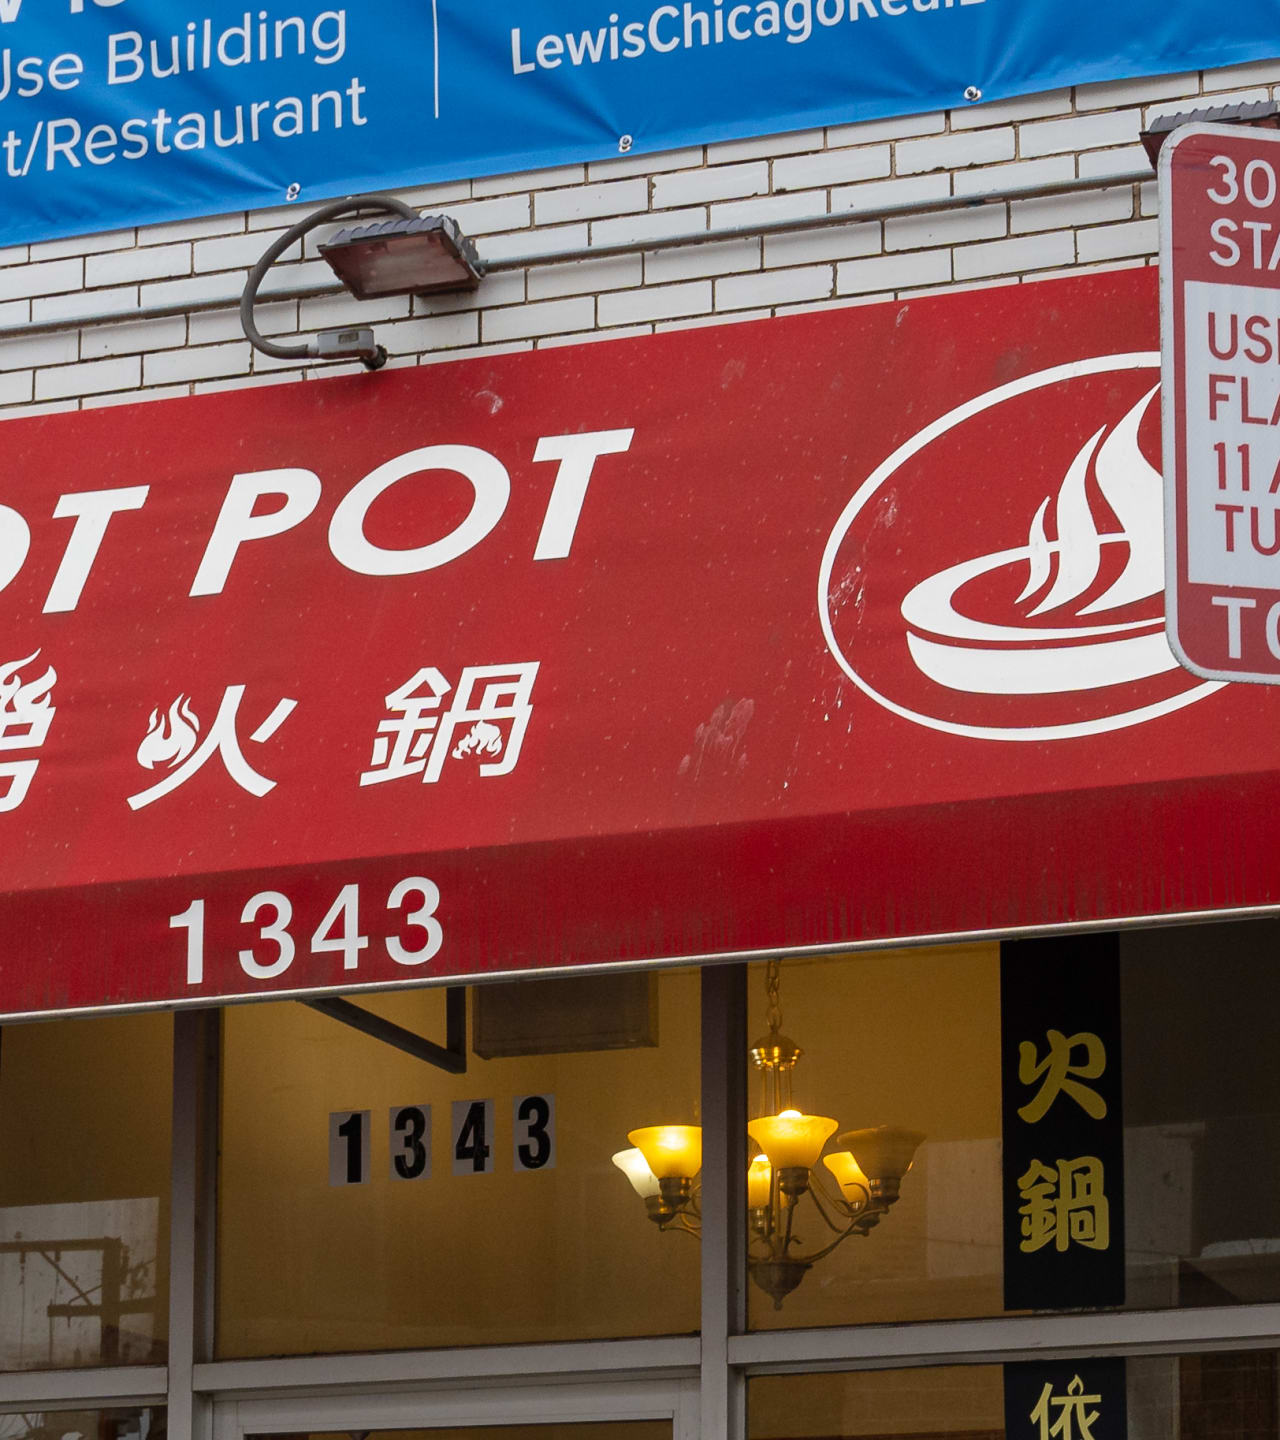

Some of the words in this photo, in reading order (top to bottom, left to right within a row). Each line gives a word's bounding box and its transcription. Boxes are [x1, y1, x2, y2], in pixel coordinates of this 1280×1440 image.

[107, 8, 347, 85] Building
[511, 0, 985, 75] LewisChicago
[1206, 155, 1277, 209] 30
[188, 428, 635, 598] POT
[168, 876, 444, 985] 1343
[335, 1102, 552, 1185] 1343
[1017, 1029, 1110, 1255] 火鍋
